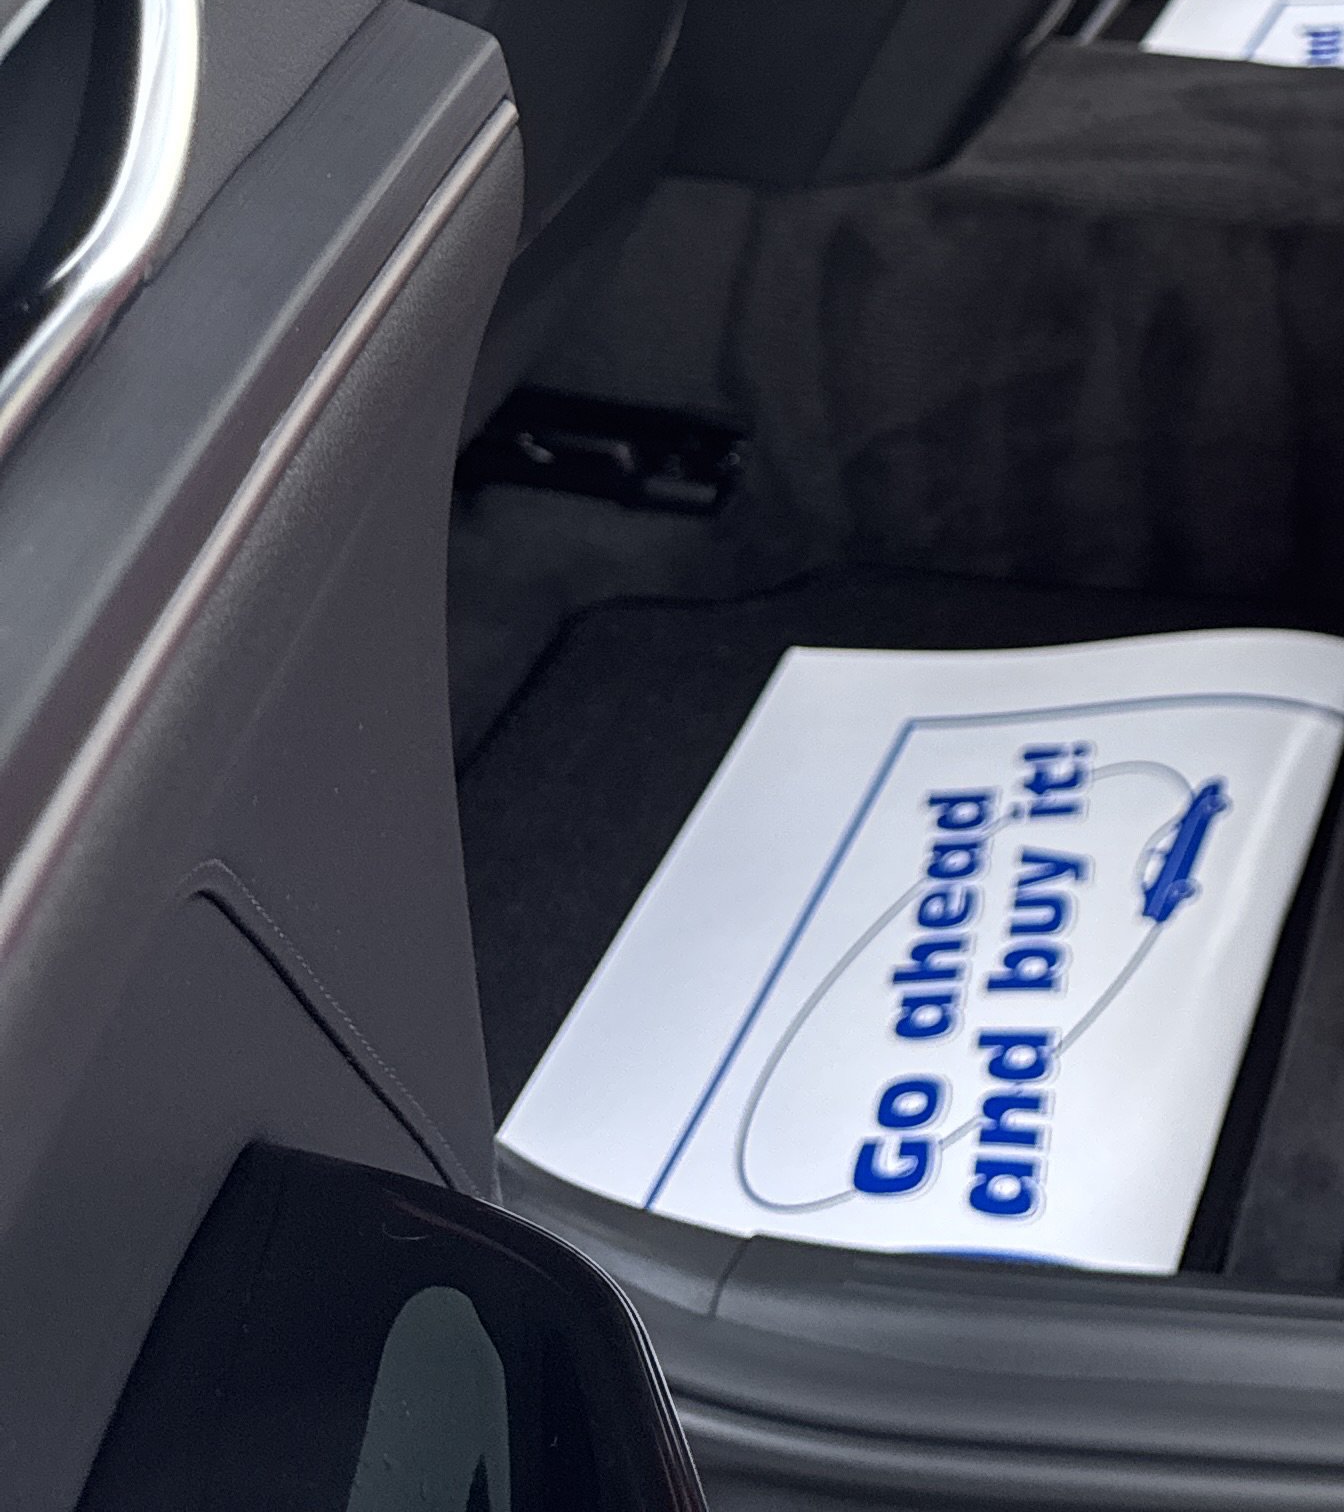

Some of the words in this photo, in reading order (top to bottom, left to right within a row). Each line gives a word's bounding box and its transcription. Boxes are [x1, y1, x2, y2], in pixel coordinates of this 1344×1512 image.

[1012, 741, 1091, 820] it!
[892, 791, 993, 1041] ahead
[985, 849, 1086, 992] buy
[851, 1075, 945, 1198] Go
[968, 1029, 1054, 1220] and
